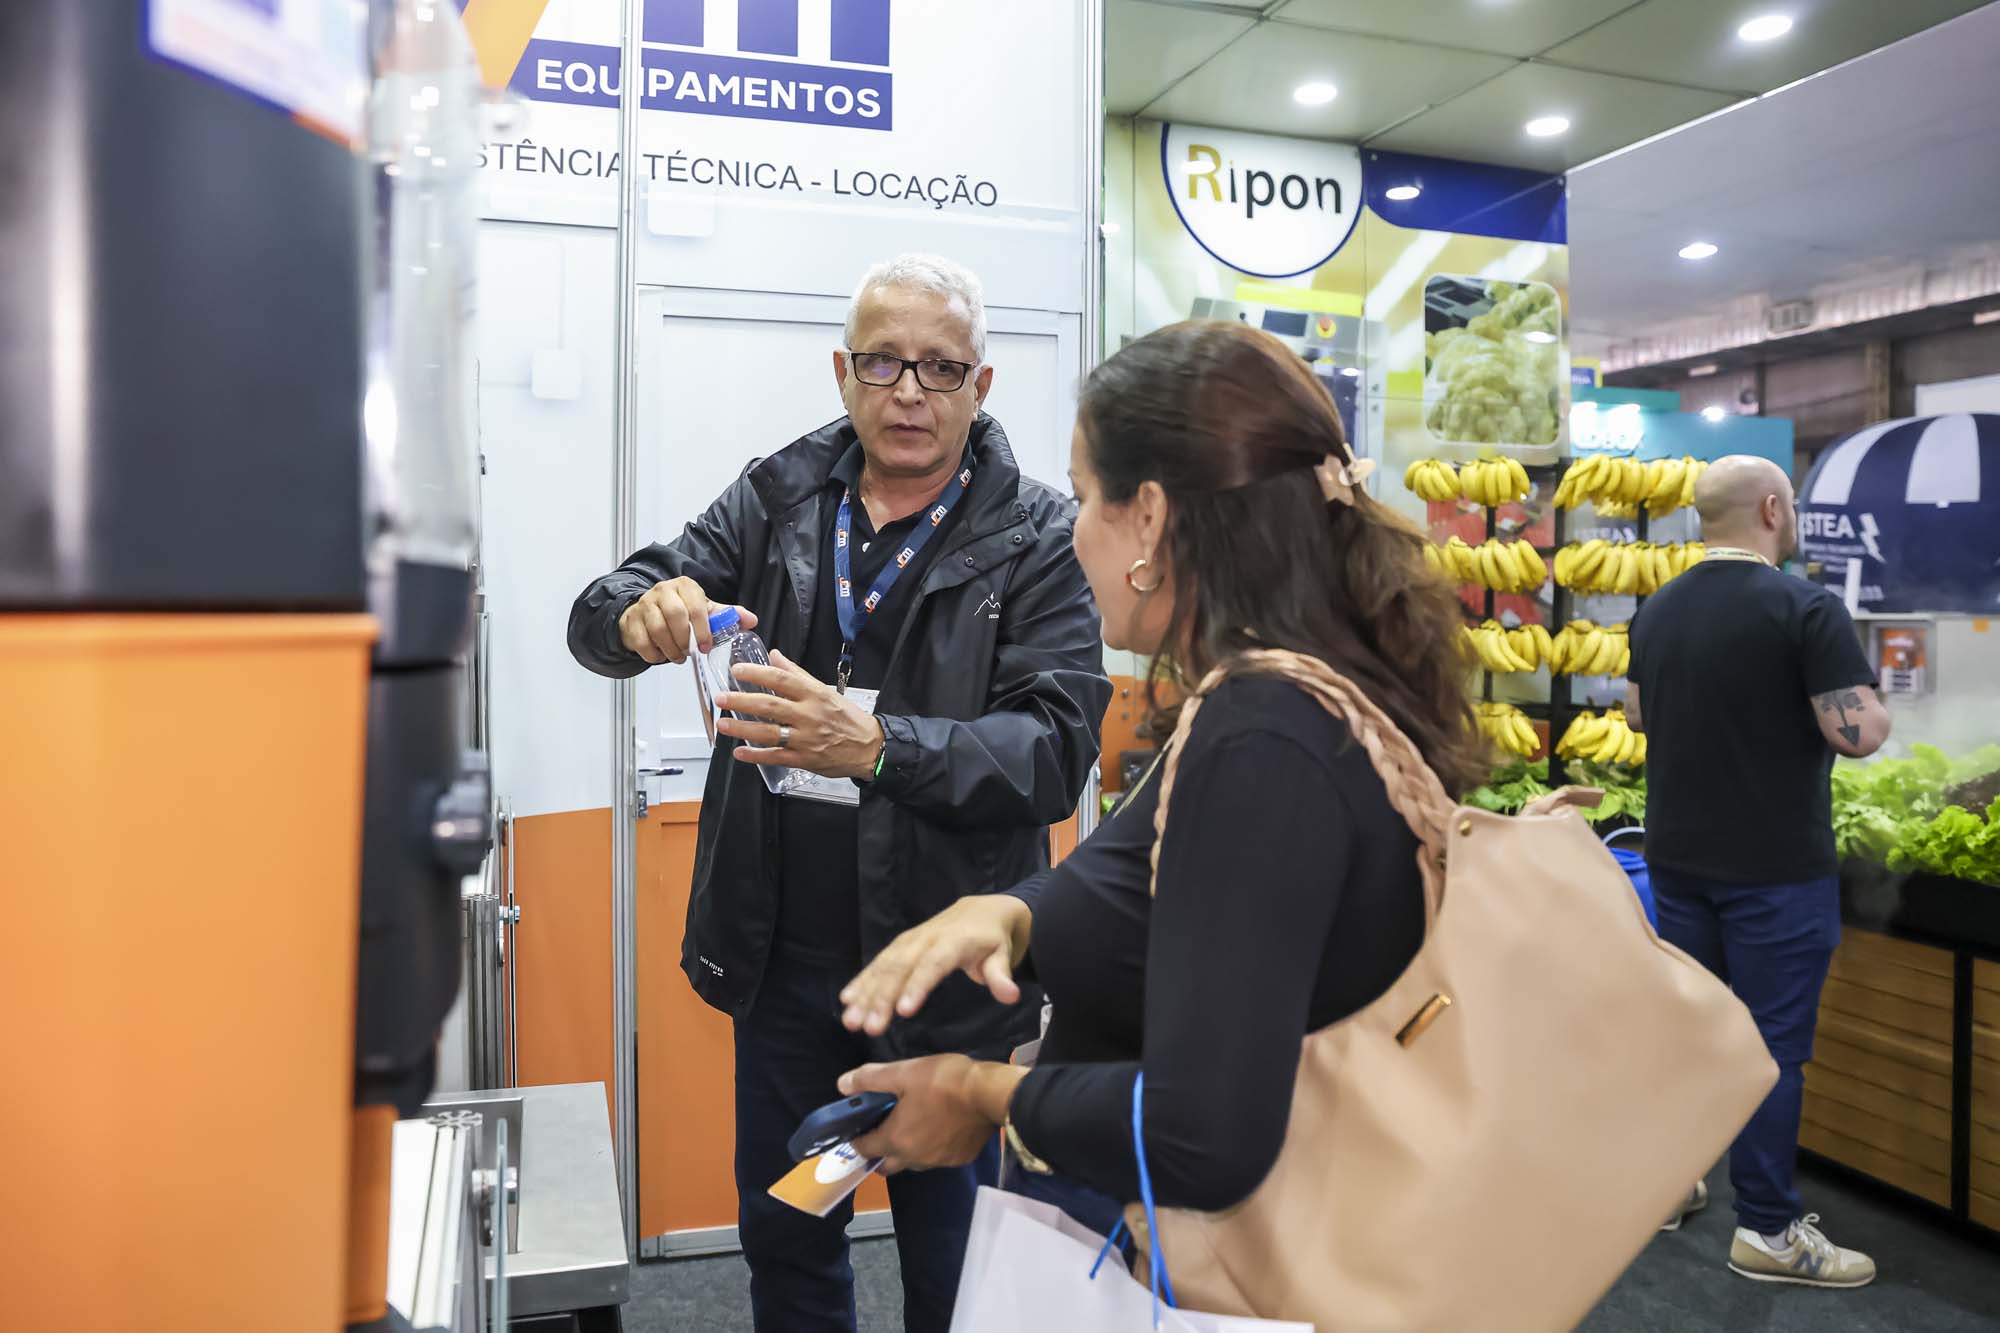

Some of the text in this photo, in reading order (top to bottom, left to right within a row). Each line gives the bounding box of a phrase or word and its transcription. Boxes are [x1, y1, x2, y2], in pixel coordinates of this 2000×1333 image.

[643, 150, 803, 191] TÉCNICA
[834, 168, 998, 209] LOCAÇÃO
[1189, 144, 1342, 219] Ripon
